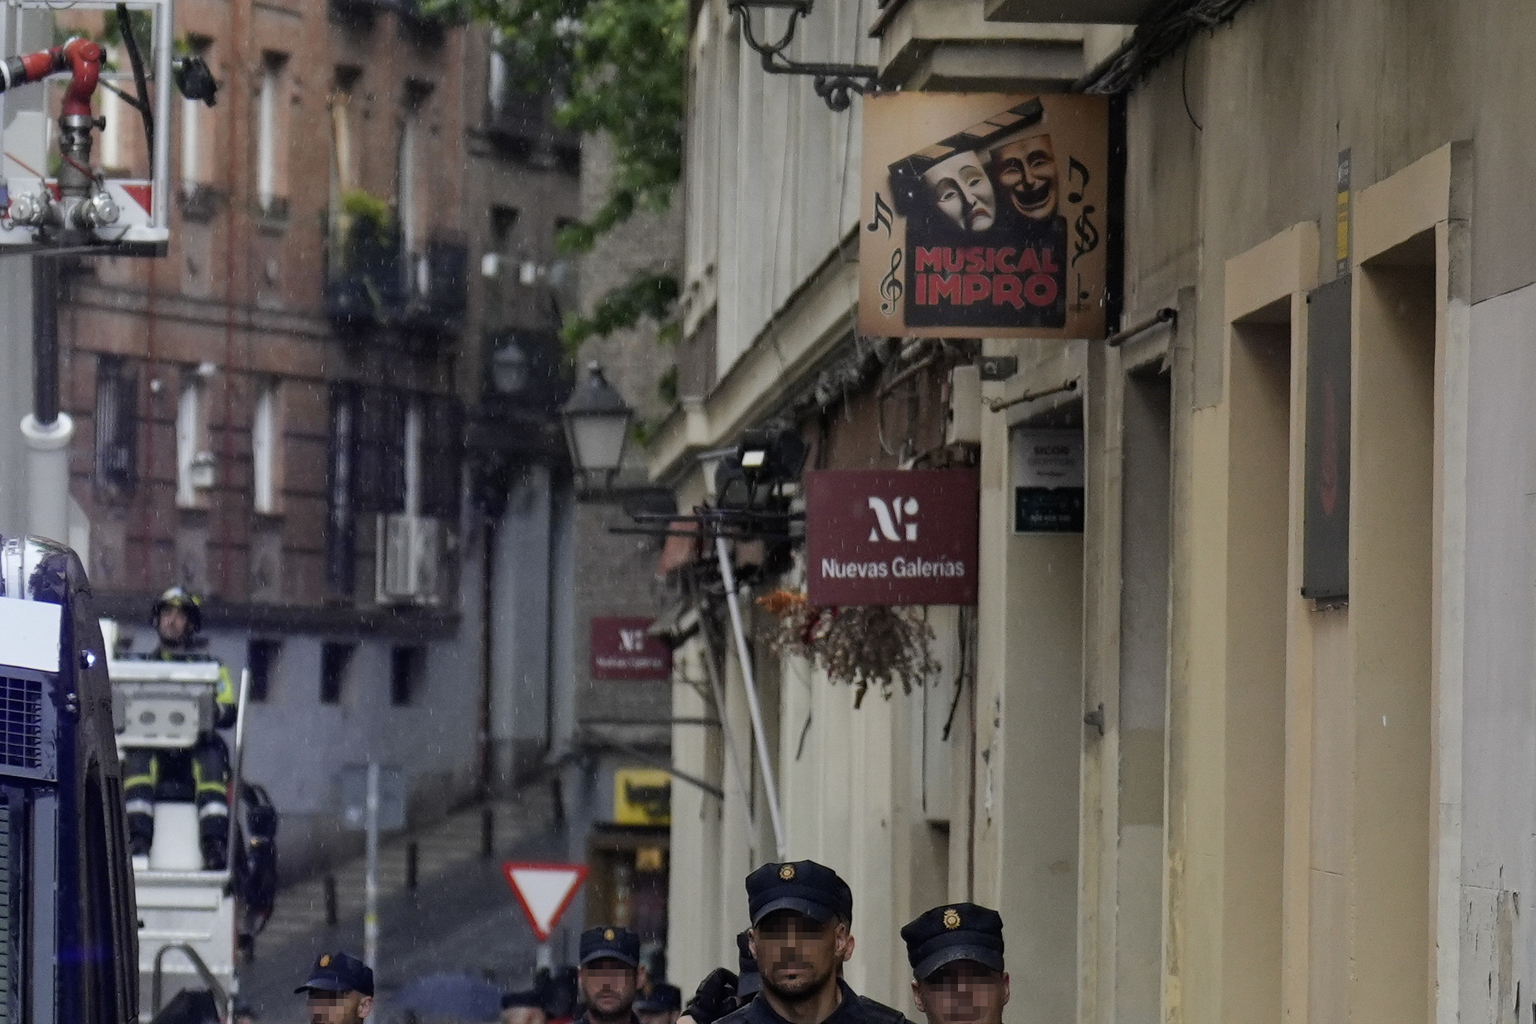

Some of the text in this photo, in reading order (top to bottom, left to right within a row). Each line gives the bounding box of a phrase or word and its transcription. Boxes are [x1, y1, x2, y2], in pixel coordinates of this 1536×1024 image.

[915, 246, 1058, 273] MUSICAL
[915, 273, 1058, 309] IMPRO
[821, 555, 965, 578] Nuevas Galerías
